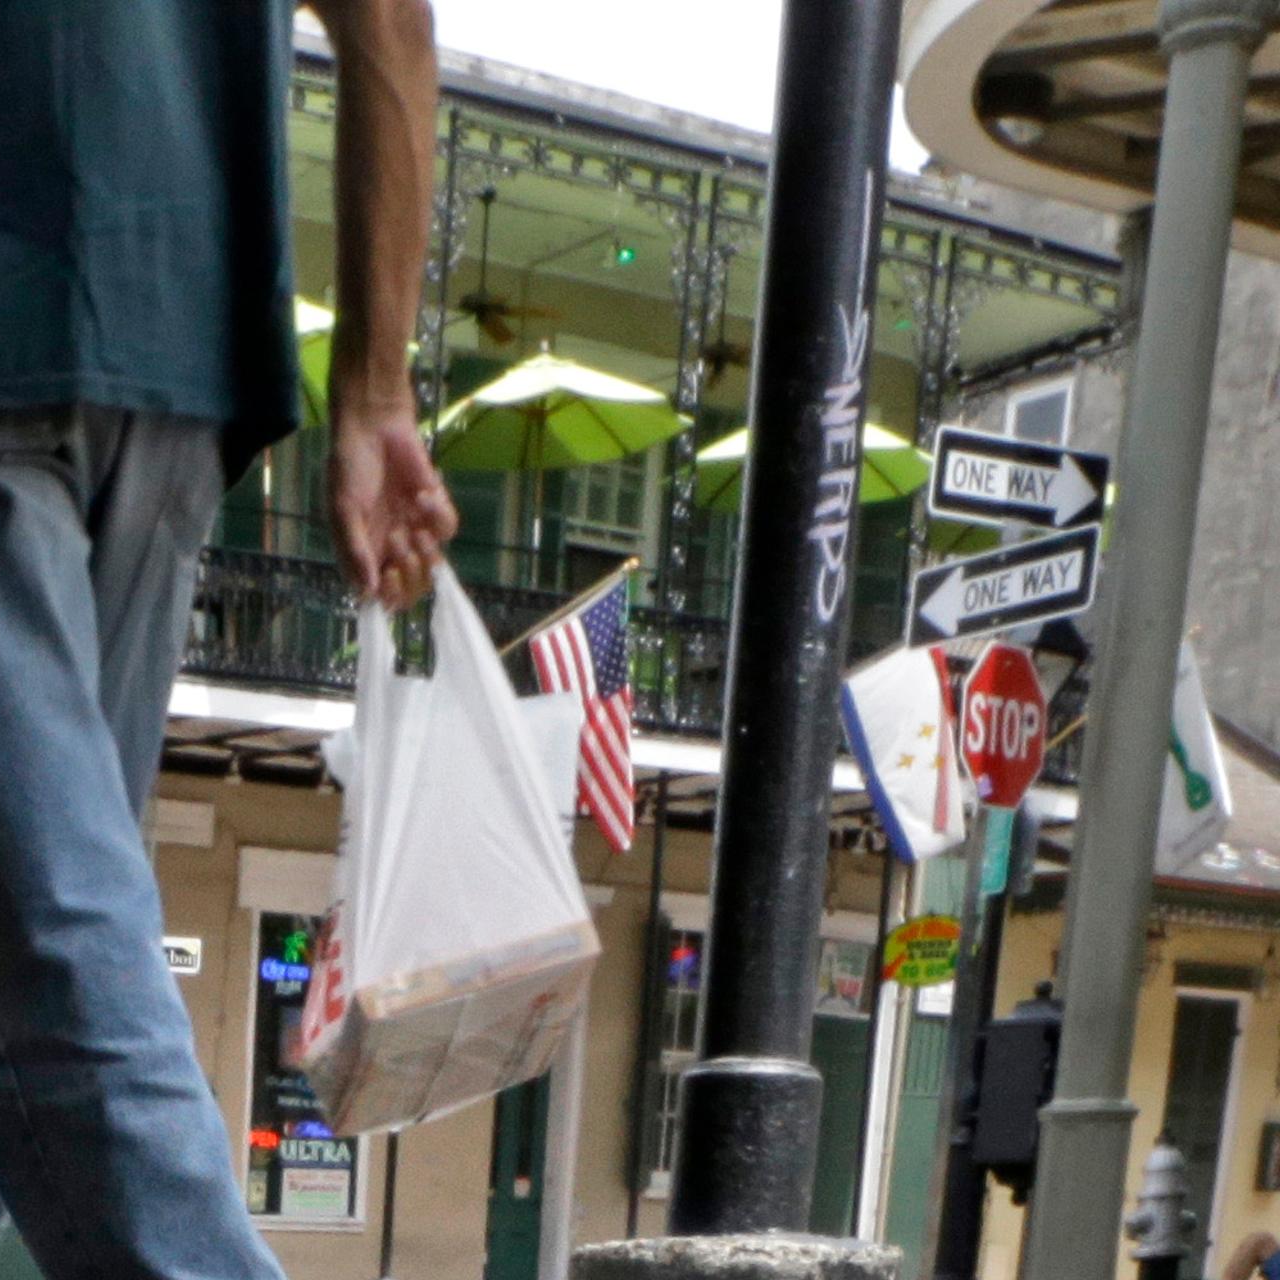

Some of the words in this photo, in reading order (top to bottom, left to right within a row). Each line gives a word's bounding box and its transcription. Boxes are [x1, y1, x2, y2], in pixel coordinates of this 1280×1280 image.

[953, 456, 998, 494] ONE
[1007, 469, 1055, 503] WAY
[964, 573, 1012, 612] ONE
[1022, 555, 1075, 597] WAY
[967, 693, 1041, 760] STOP
[280, 1138, 351, 1163] ULTRA
